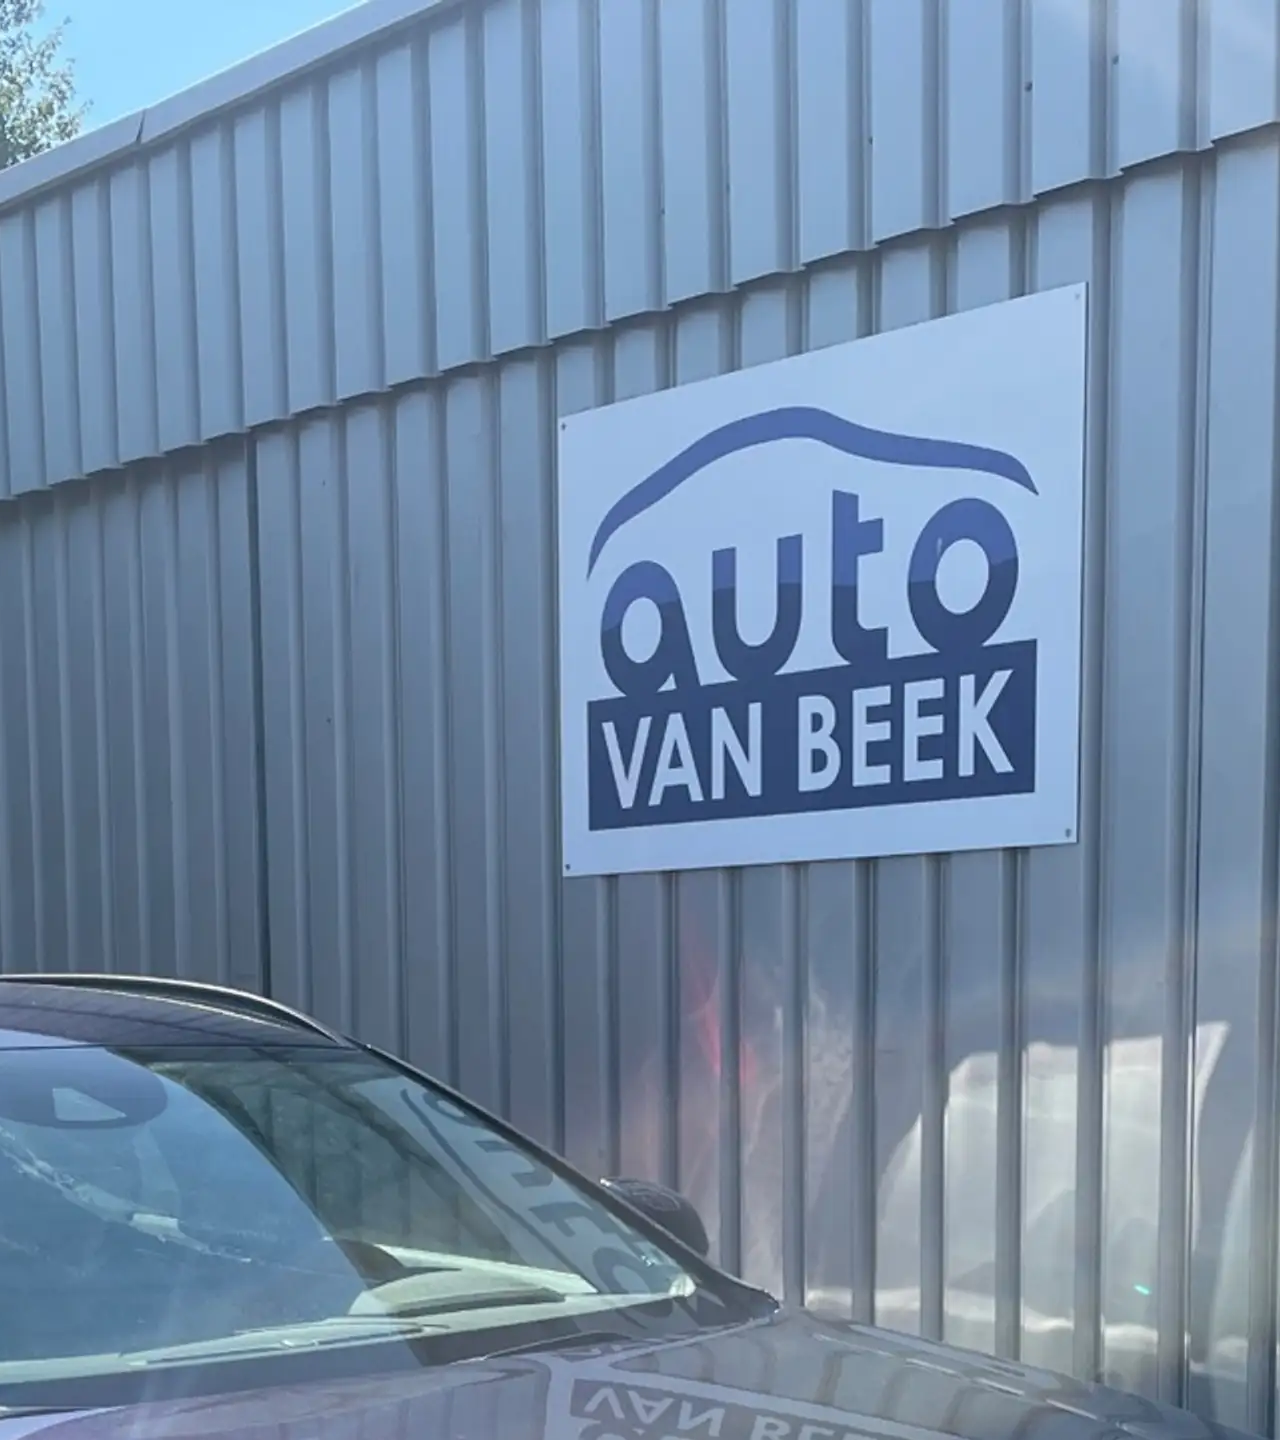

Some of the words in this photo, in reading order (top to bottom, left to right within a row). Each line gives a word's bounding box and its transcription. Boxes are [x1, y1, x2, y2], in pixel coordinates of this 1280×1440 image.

[601, 490, 1019, 696] auto
[602, 702, 762, 810] VAN
[797, 669, 1015, 793] BEEK
